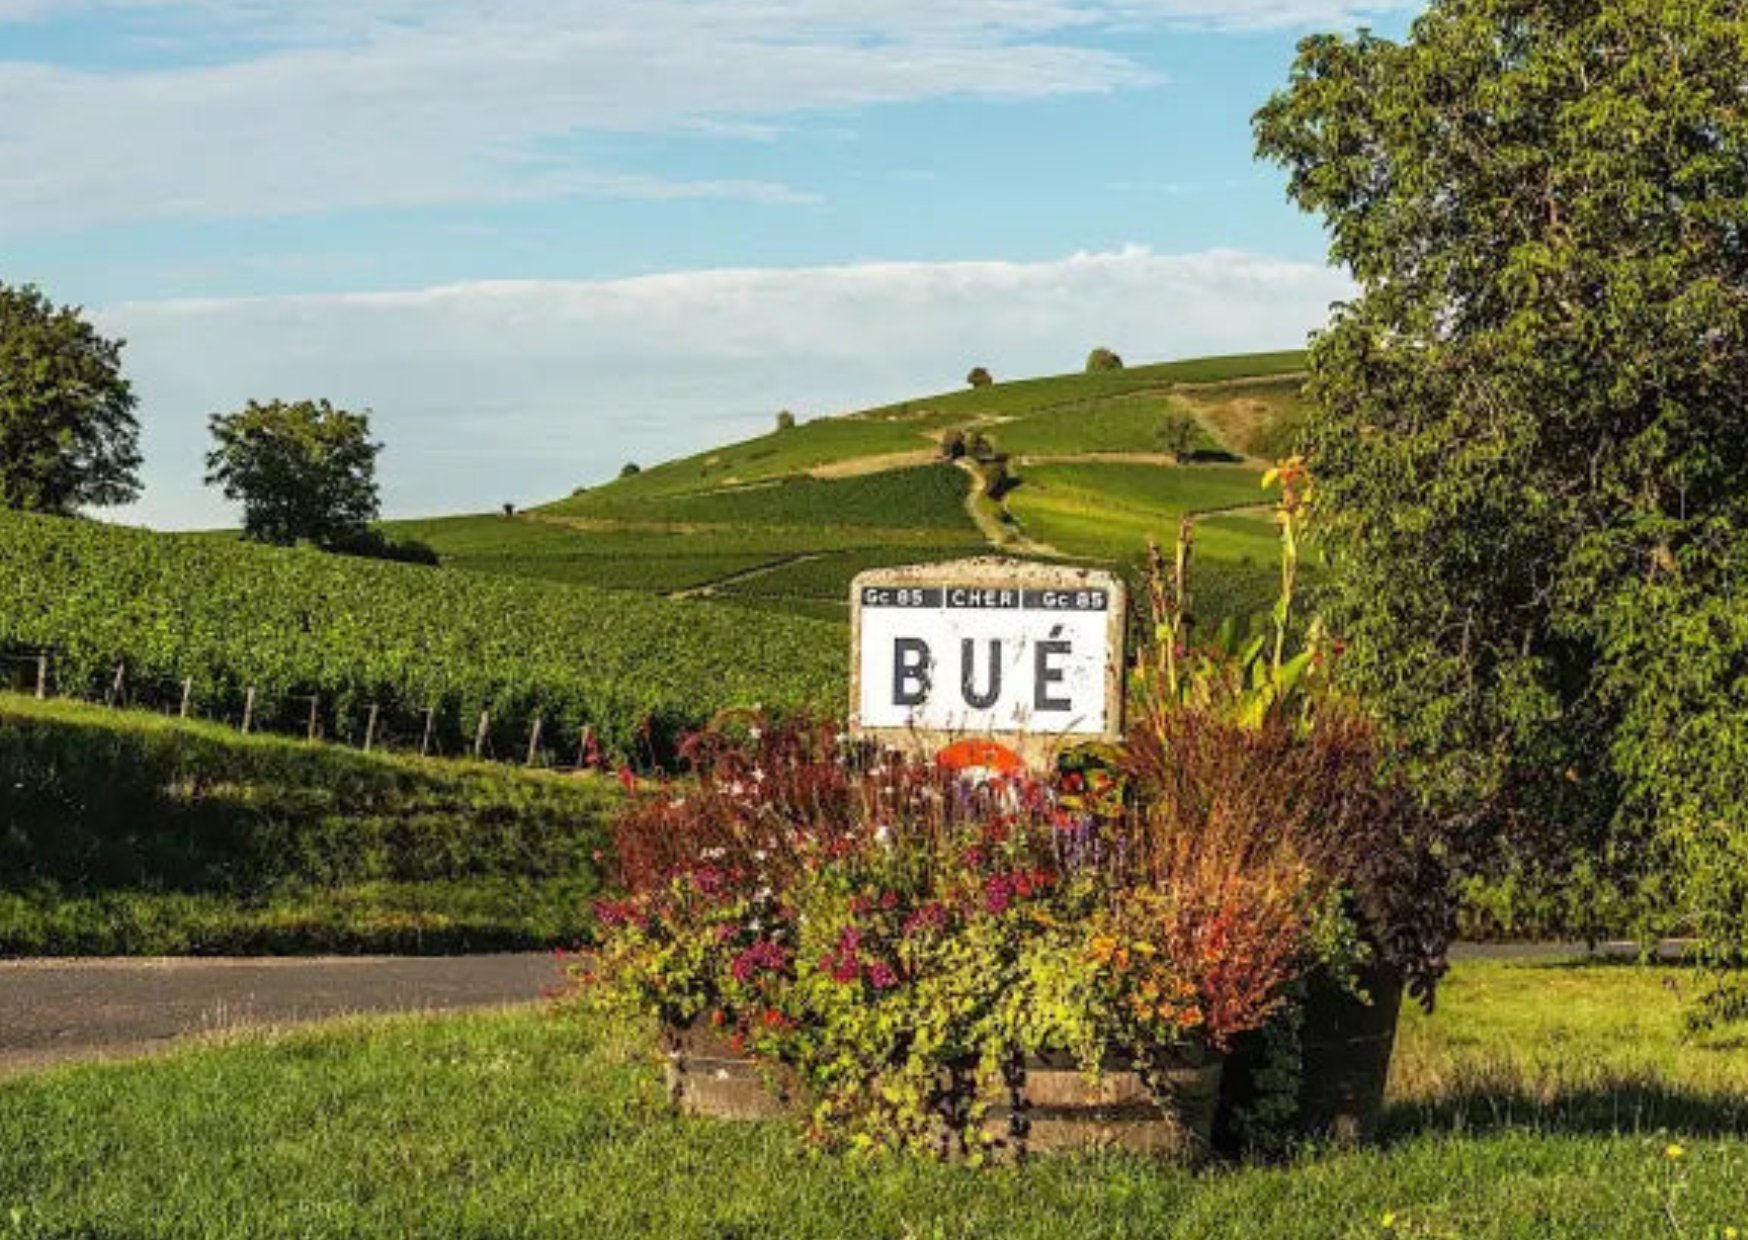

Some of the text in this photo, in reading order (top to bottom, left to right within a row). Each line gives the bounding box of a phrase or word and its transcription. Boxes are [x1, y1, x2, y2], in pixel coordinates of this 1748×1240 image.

[865, 589, 923, 605] Gc 85
[951, 590, 1012, 606] CHER
[1043, 592, 1104, 608] Gc 85
[893, 625, 1072, 711] BUÉ
